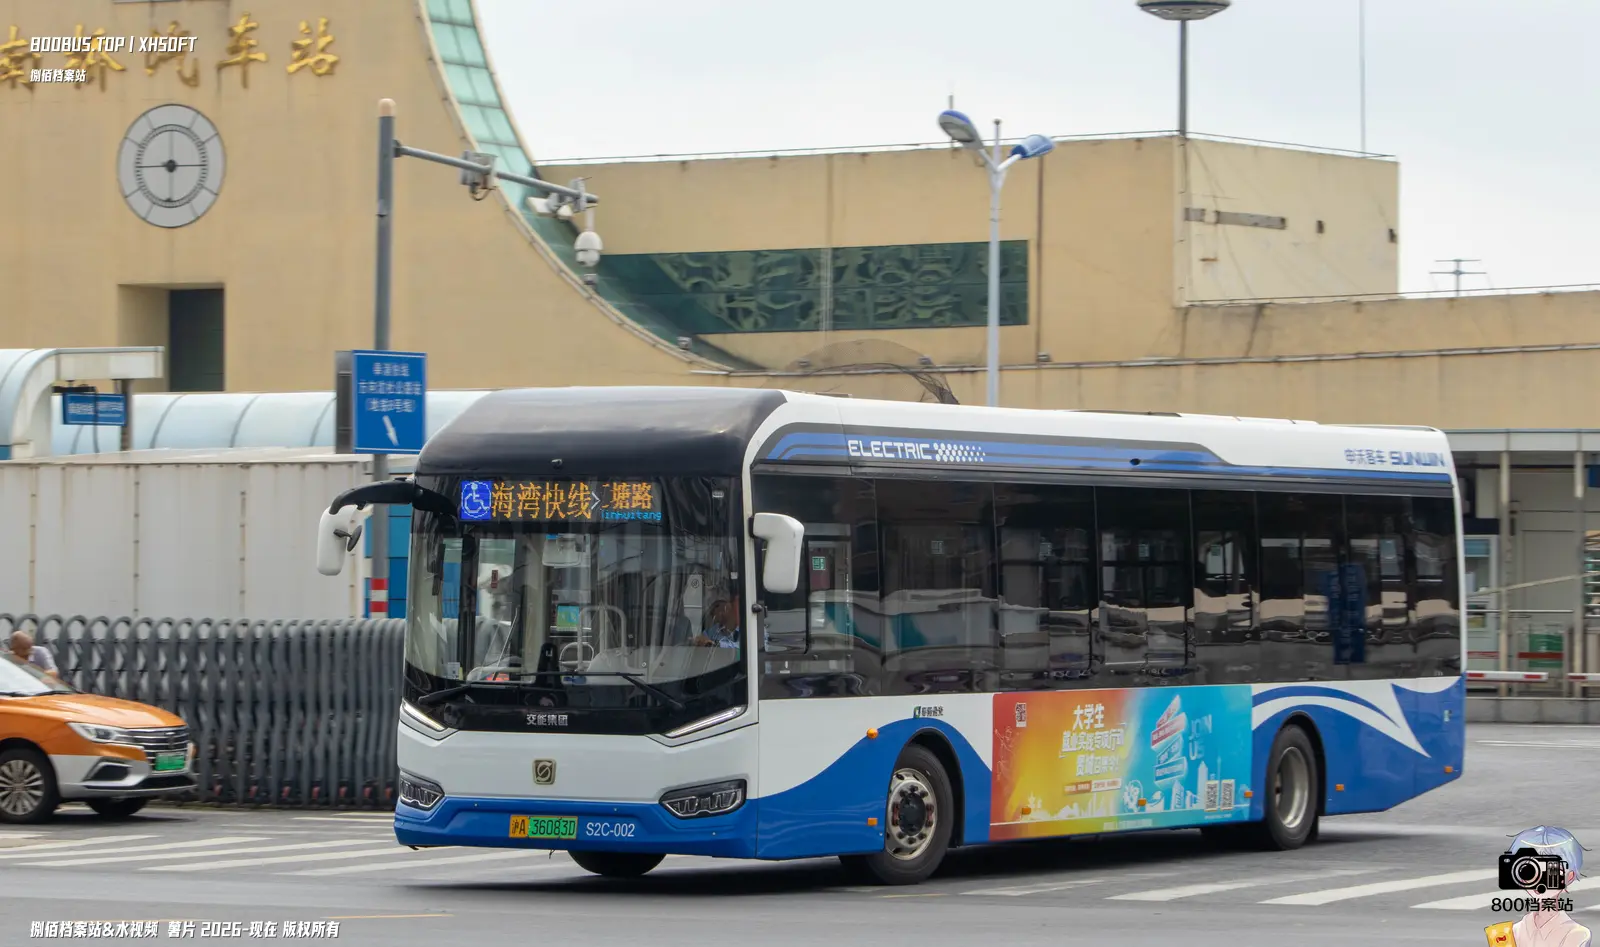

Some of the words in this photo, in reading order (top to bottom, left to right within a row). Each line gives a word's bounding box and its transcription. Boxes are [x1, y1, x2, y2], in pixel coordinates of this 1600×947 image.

[847, 439, 932, 460] ELECTRIC
[1389, 450, 1446, 467] SUNWIN
[491, 481, 593, 519] 海湾快线
[526, 713, 569, 727] 交能集团
[1072, 703, 1106, 730] 大学生
[585, 821, 636, 838] S2C-002
